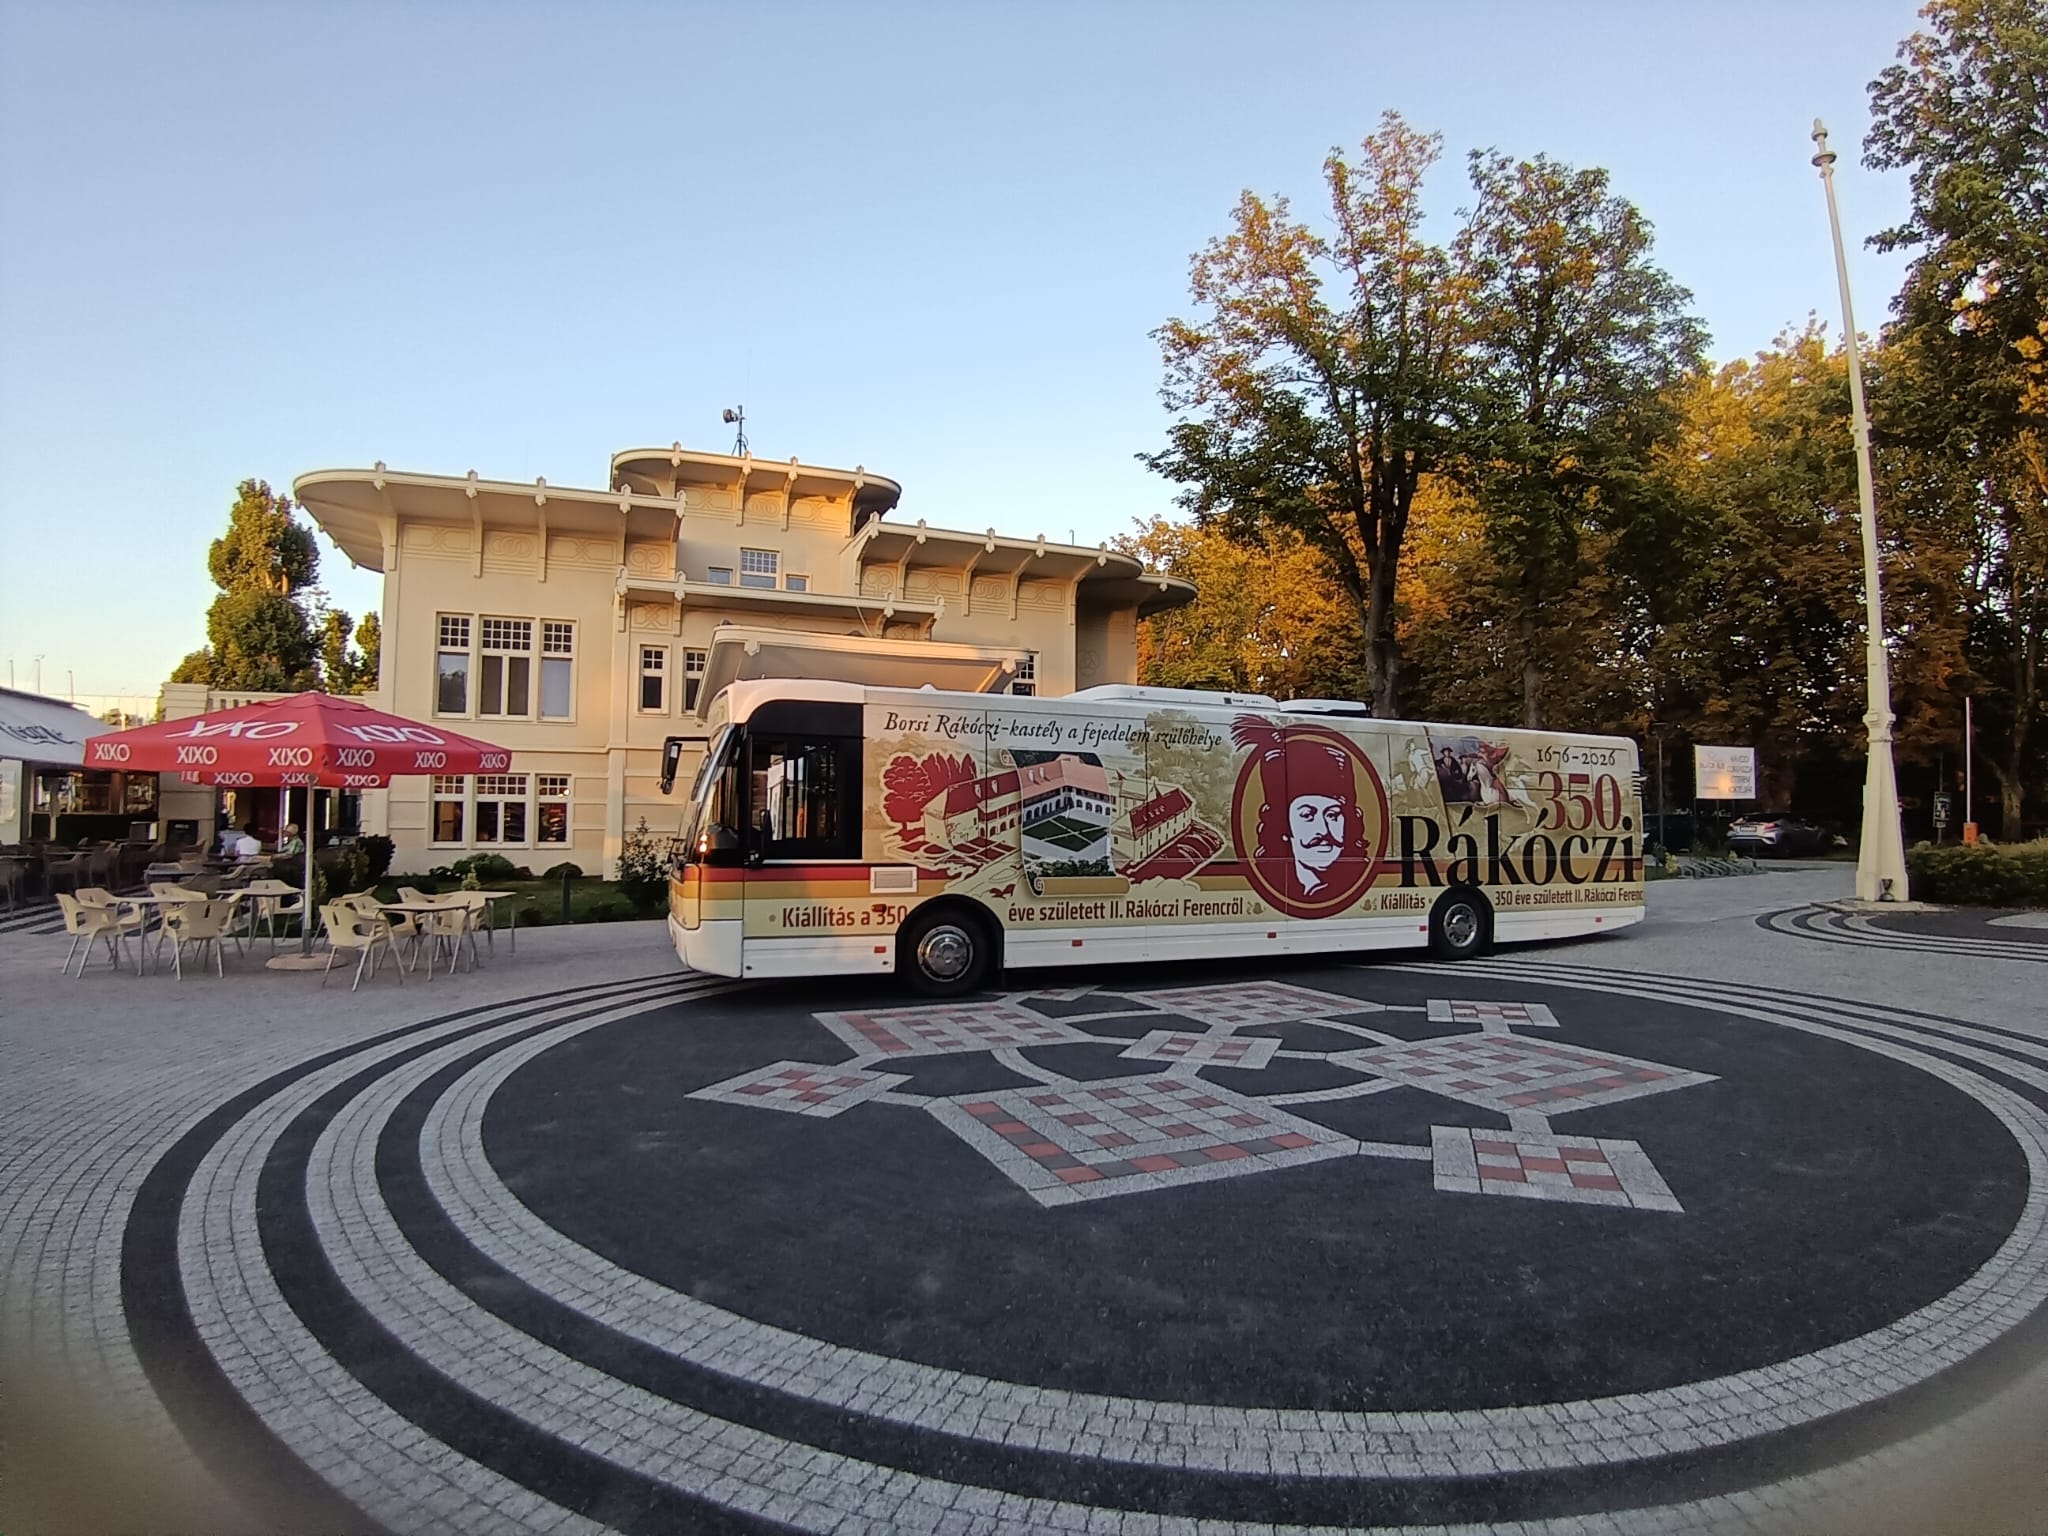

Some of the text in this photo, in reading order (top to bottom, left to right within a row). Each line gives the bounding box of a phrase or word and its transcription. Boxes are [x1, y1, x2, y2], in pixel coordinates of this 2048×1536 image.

[883, 711, 1222, 752] Borsi Rákóczi-kastély a fejedelem szülőhelye
[94, 743, 131, 762] XIXO
[176, 745, 218, 765] XIXO
[267, 747, 313, 767] XIXO
[336, 748, 376, 768] XIXO
[414, 751, 447, 769] XIXO
[479, 753, 508, 769] XIXO
[1537, 745, 1616, 770] 1676-2026
[214, 772, 254, 785] XIXO
[344, 774, 381, 787] XIXO
[1538, 771, 1622, 831] 350
[1396, 805, 1637, 888] Rákóczi
[1380, 892, 1426, 911] Kiállítás
[1495, 890, 1513, 906] 350
[1515, 889, 1532, 905] éve
[1533, 889, 1573, 905] született
[1574, 889, 1584, 903] II.
[1584, 887, 1617, 903] Rákóczi
[782, 905, 855, 928] Kiállítás
[860, 910, 871, 926] a
[1008, 902, 1035, 922] éve
[1039, 901, 1106, 921] született
[1109, 901, 1124, 919] II.
[1125, 899, 1179, 919] Rákóczi
[1183, 897, 1243, 917] Ferencről
